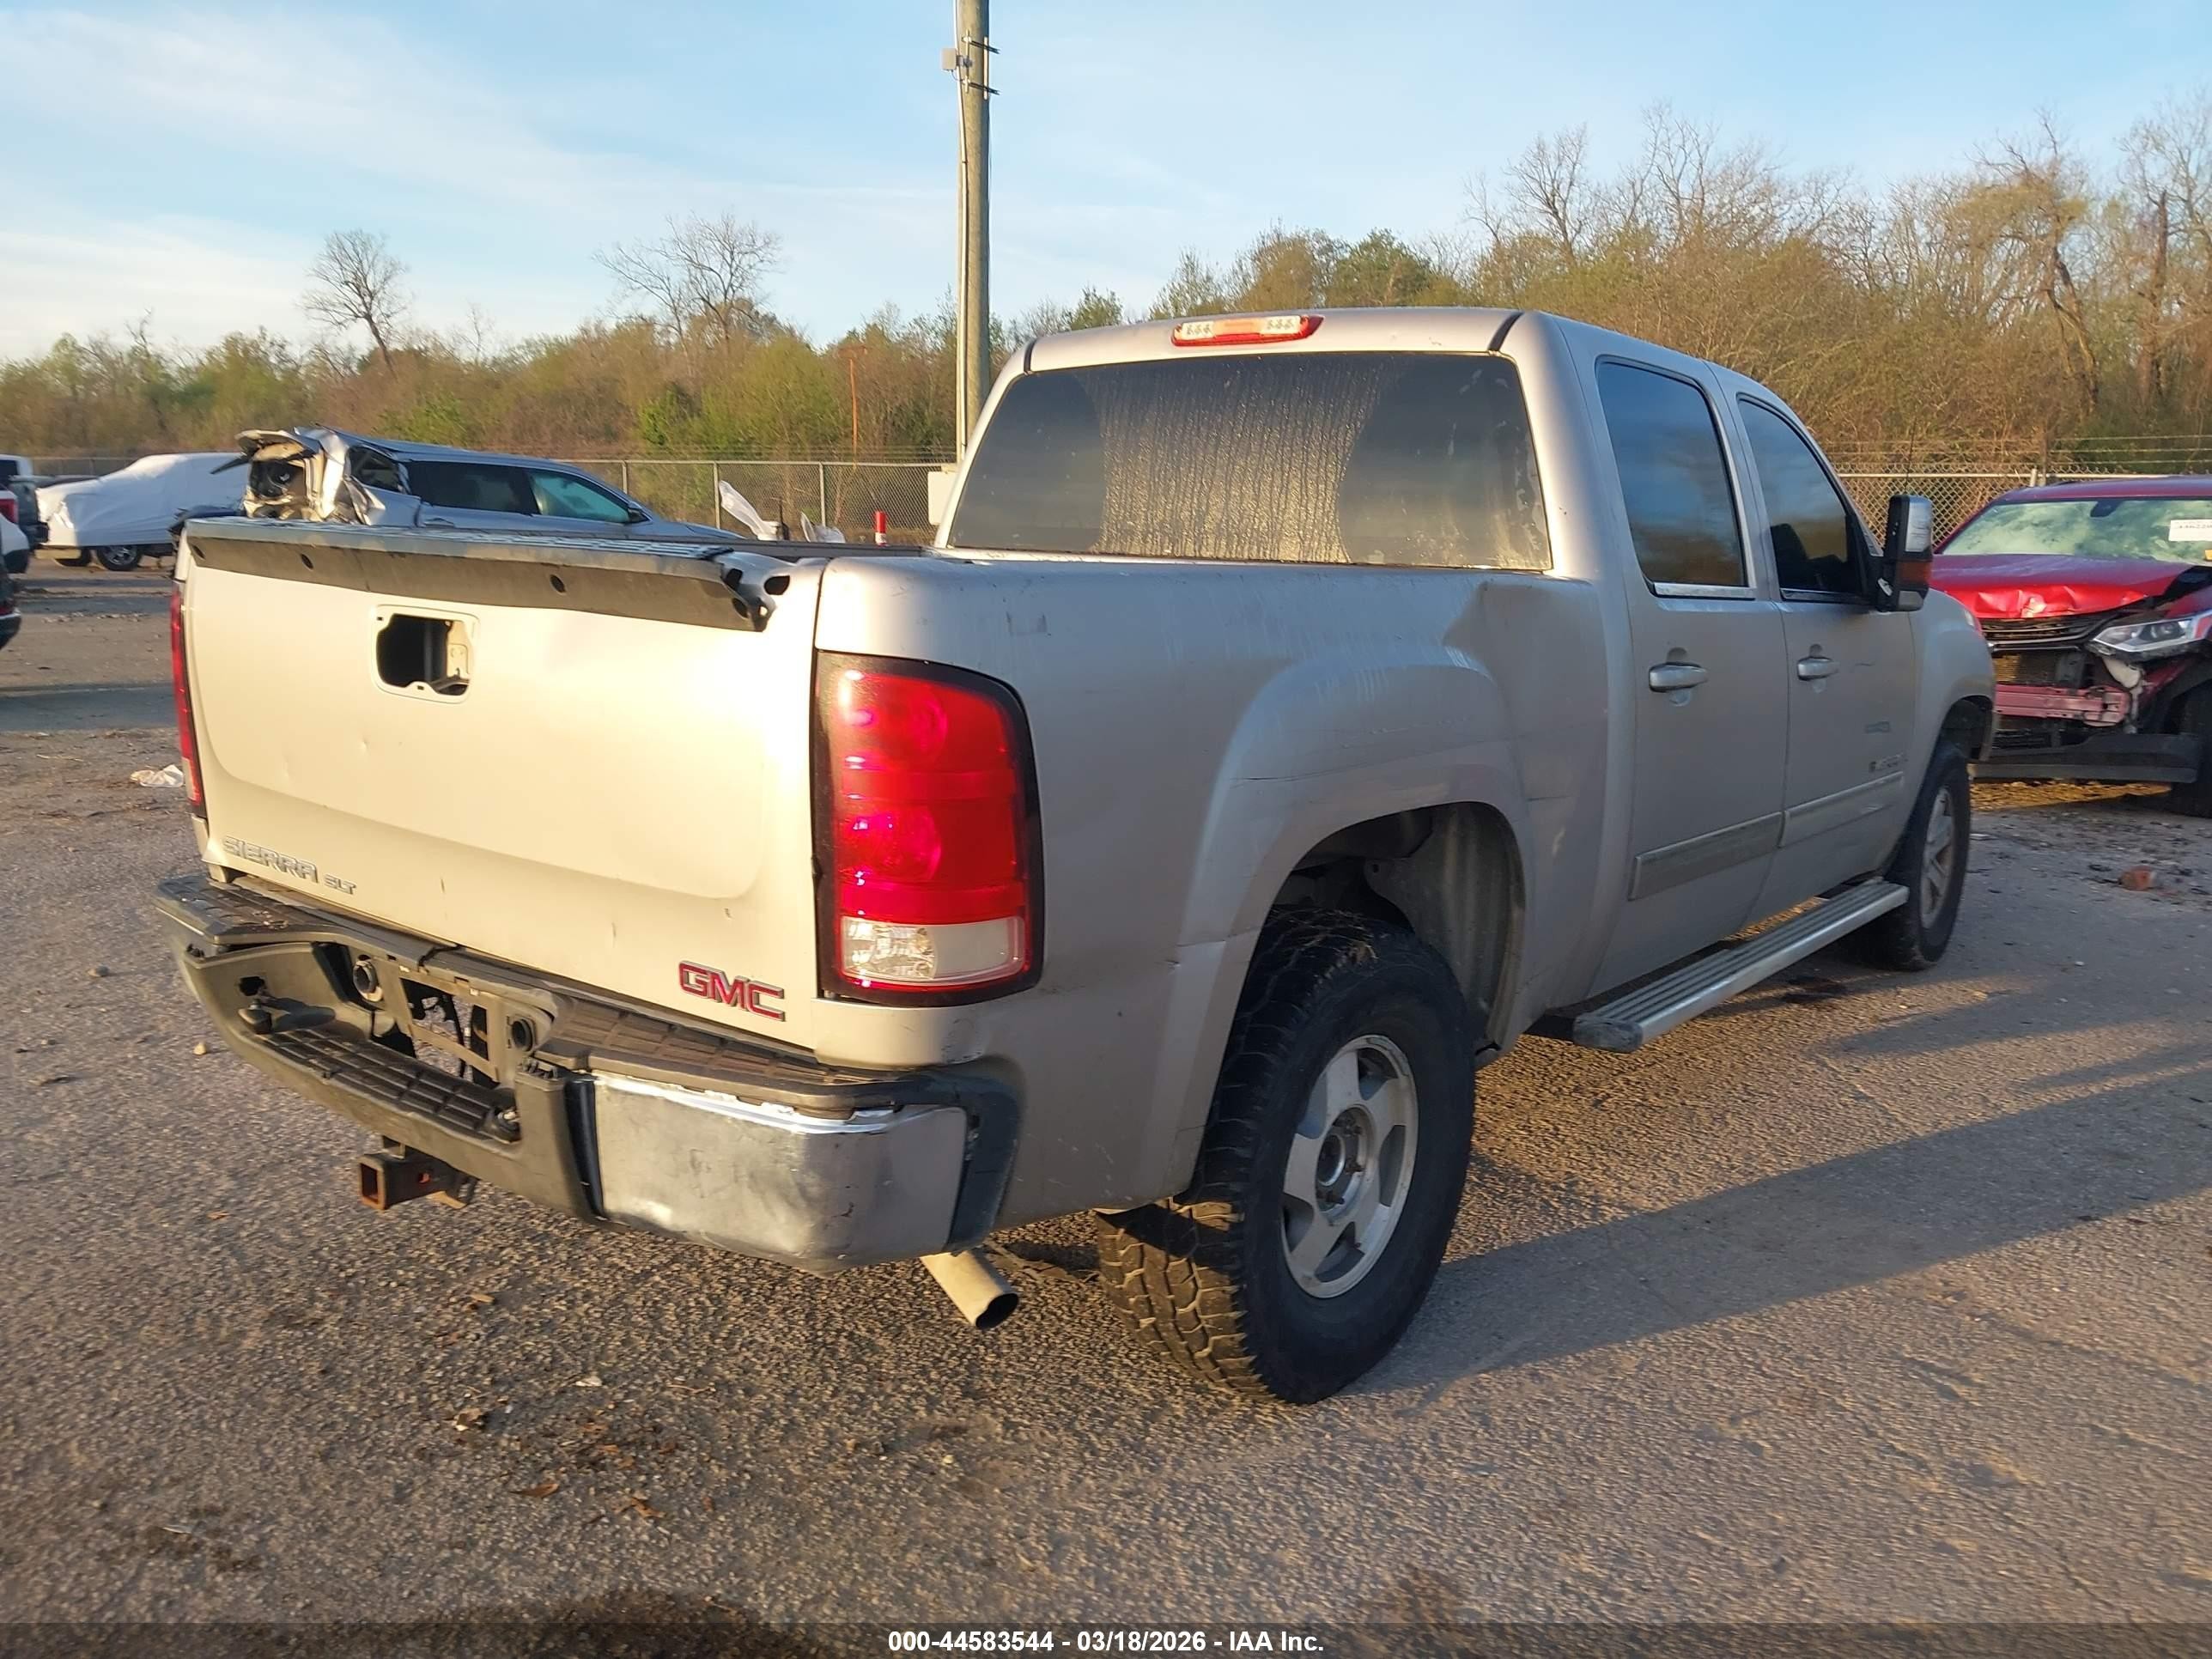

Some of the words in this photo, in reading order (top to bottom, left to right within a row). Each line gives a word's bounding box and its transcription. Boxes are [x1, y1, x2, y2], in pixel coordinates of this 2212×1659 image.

[222, 836, 319, 883] SIERRA
[325, 873, 356, 895] SLT
[678, 960, 786, 1022] GMC
